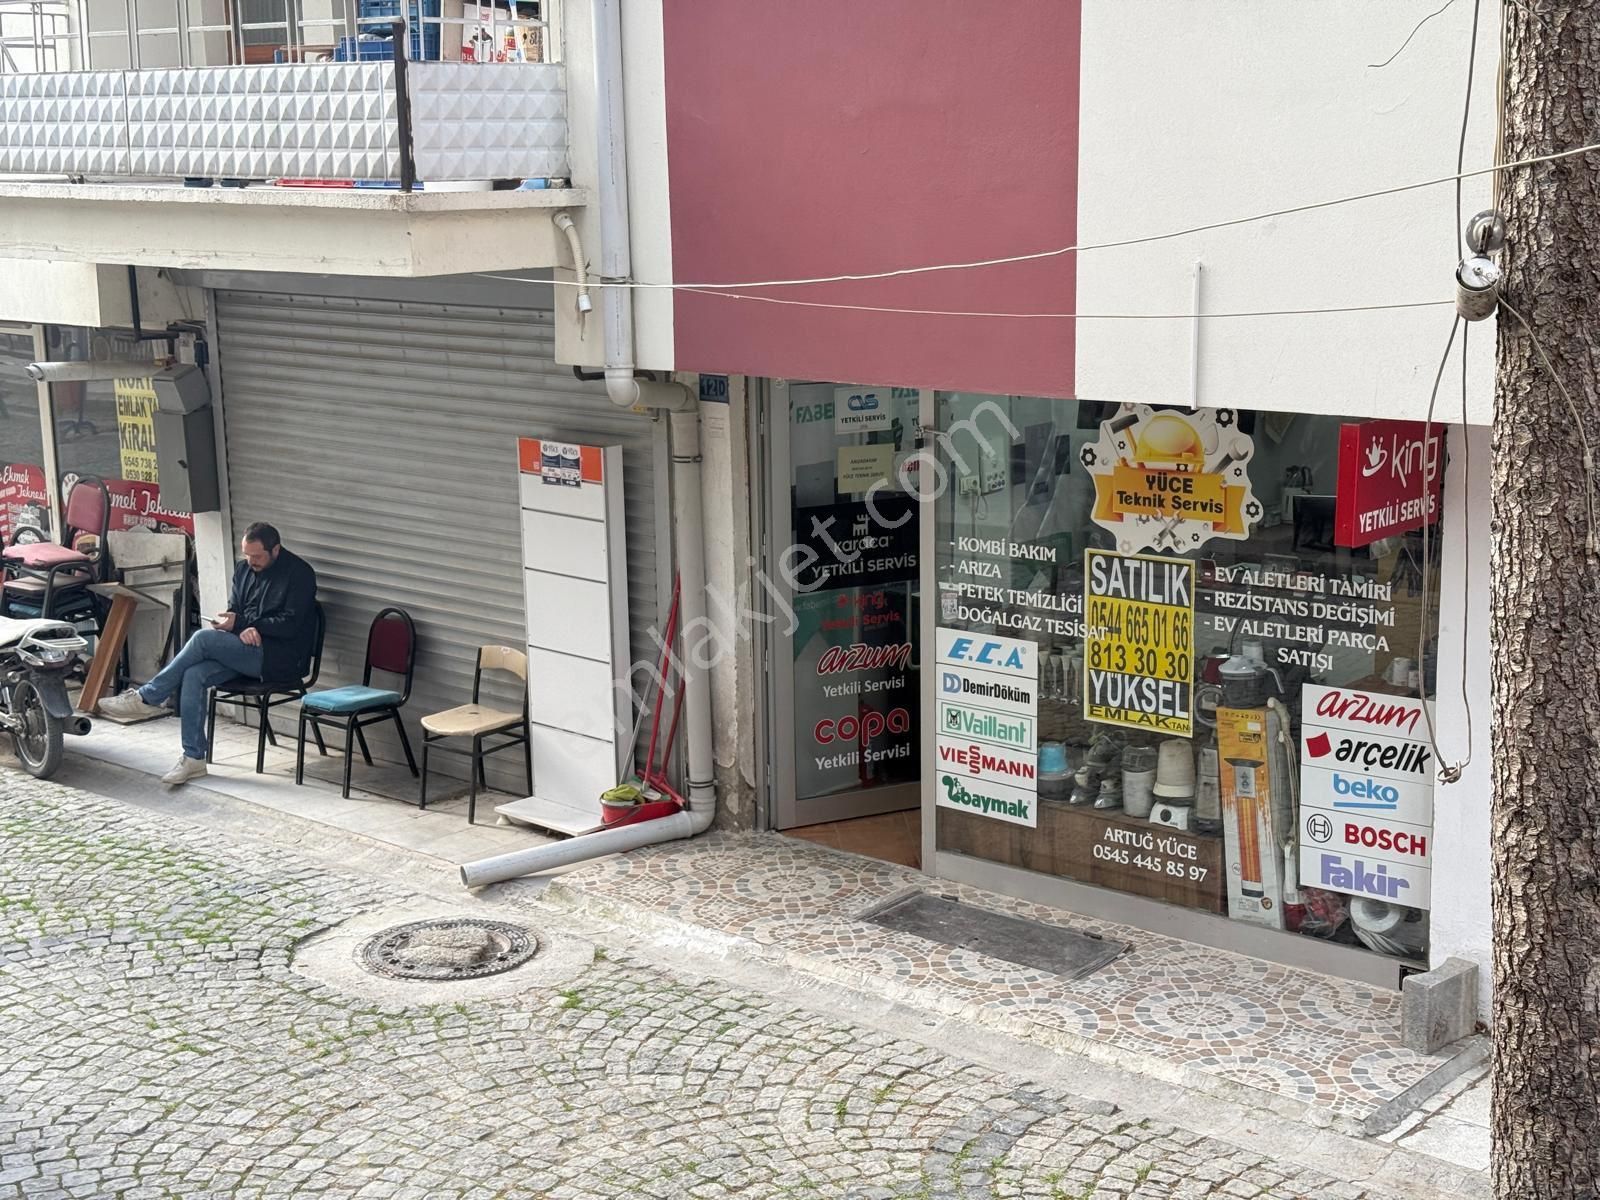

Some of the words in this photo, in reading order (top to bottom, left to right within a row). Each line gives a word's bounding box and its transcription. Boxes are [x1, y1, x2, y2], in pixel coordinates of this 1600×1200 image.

[1391, 433, 1438, 488] king
[1145, 472, 1193, 494] YÜCE
[1116, 490, 1165, 509] Teknik
[1171, 495, 1223, 514] Servis
[1359, 499, 1399, 533] YETKİLİ
[834, 535, 889, 553] karaca
[958, 536, 1006, 556] KOMBİ
[1009, 542, 1056, 562] BAKIM
[812, 557, 864, 578] YETKİLİ
[867, 553, 917, 572] SERVİS
[958, 560, 1002, 578] ARIZA
[1091, 555, 1190, 607] SATILIK
[958, 582, 1004, 602] PETEK
[1006, 588, 1082, 614] TEMİZLİĞİ
[1215, 566, 1238, 583] EV
[1241, 571, 1325, 593] ALETLERİ
[1329, 578, 1392, 602] TAMİRİ
[958, 606, 1042, 631] DOĞALGAZ
[1091, 600, 1122, 642] 0544
[1126, 604, 1149, 646] 665
[1153, 608, 1168, 649] 01
[1173, 611, 1189, 651] 66
[1214, 590, 1309, 618] REZİSTANS
[1313, 602, 1395, 628] DEĞİŞİMİ
[1214, 616, 1238, 633] EV
[1241, 619, 1324, 644] ALETLERİ
[1328, 629, 1390, 655] PARÇA
[816, 642, 912, 676] arzum
[1090, 641, 1127, 671] 813
[1134, 647, 1157, 676] 30
[1165, 652, 1189, 681] 30
[1277, 647, 1333, 673] SATIŞI
[823, 681, 861, 698] Yetkili
[864, 675, 905, 693] Servisi
[963, 678, 1030, 704] DemirDöküm
[1089, 669, 1189, 719] YÜKSEL
[814, 707, 910, 747] copa
[963, 711, 1026, 743] Vaillant
[1316, 690, 1421, 735] arzum
[815, 751, 860, 770] Yetkili
[863, 743, 910, 763] Servisi
[939, 745, 1034, 779] VIESSMANN
[1335, 738, 1431, 774] arçelik
[961, 787, 1029, 819] baymak
[1333, 773, 1399, 803] beko
[1104, 827, 1153, 850] ARTUĞ
[1157, 837, 1197, 860] YÜCE
[1345, 823, 1426, 857] BOSCH
[1093, 844, 1129, 864] 0545
[1133, 854, 1161, 872] 445
[1166, 861, 1184, 878] 85
[1189, 866, 1208, 882] 97
[1320, 853, 1410, 898] Fakir
